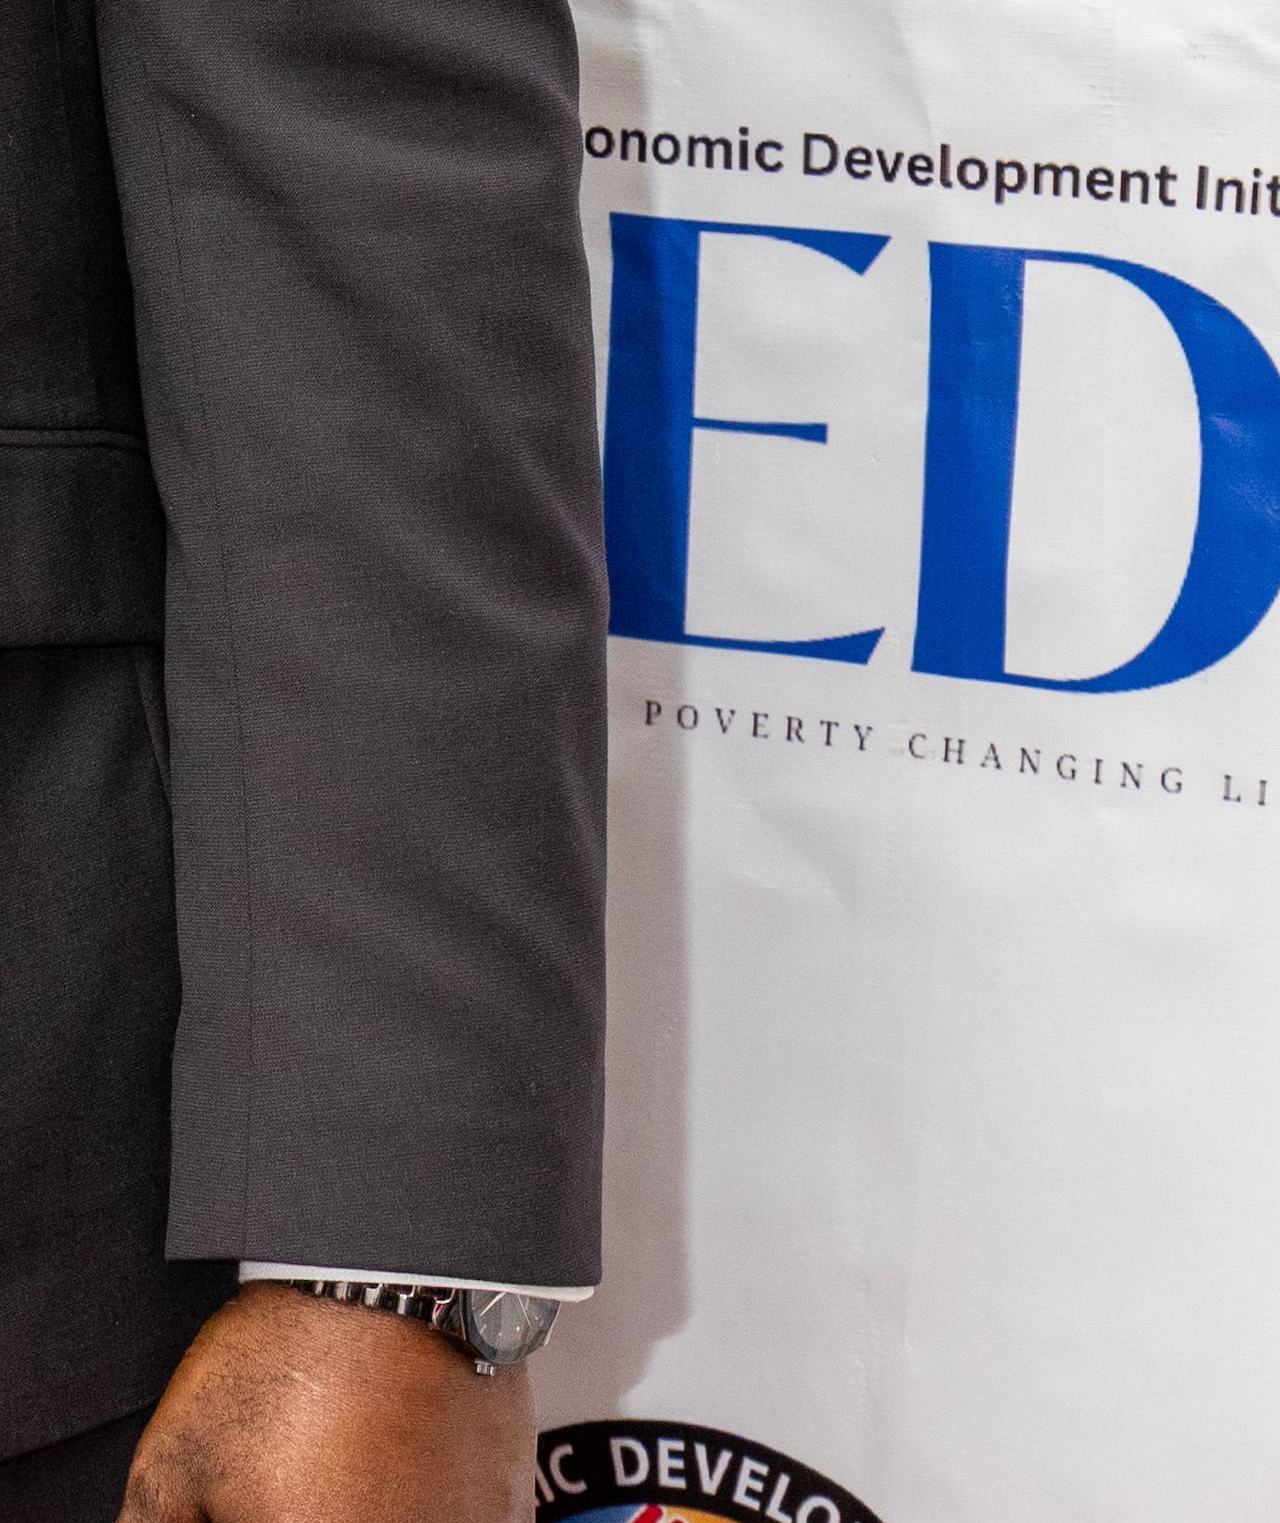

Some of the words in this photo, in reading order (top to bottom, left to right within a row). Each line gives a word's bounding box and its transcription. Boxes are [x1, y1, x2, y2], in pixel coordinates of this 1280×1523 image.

[802, 133, 1177, 208] Development
[643, 699, 875, 752] POVERTY
[907, 733, 1186, 796] CHANGING
